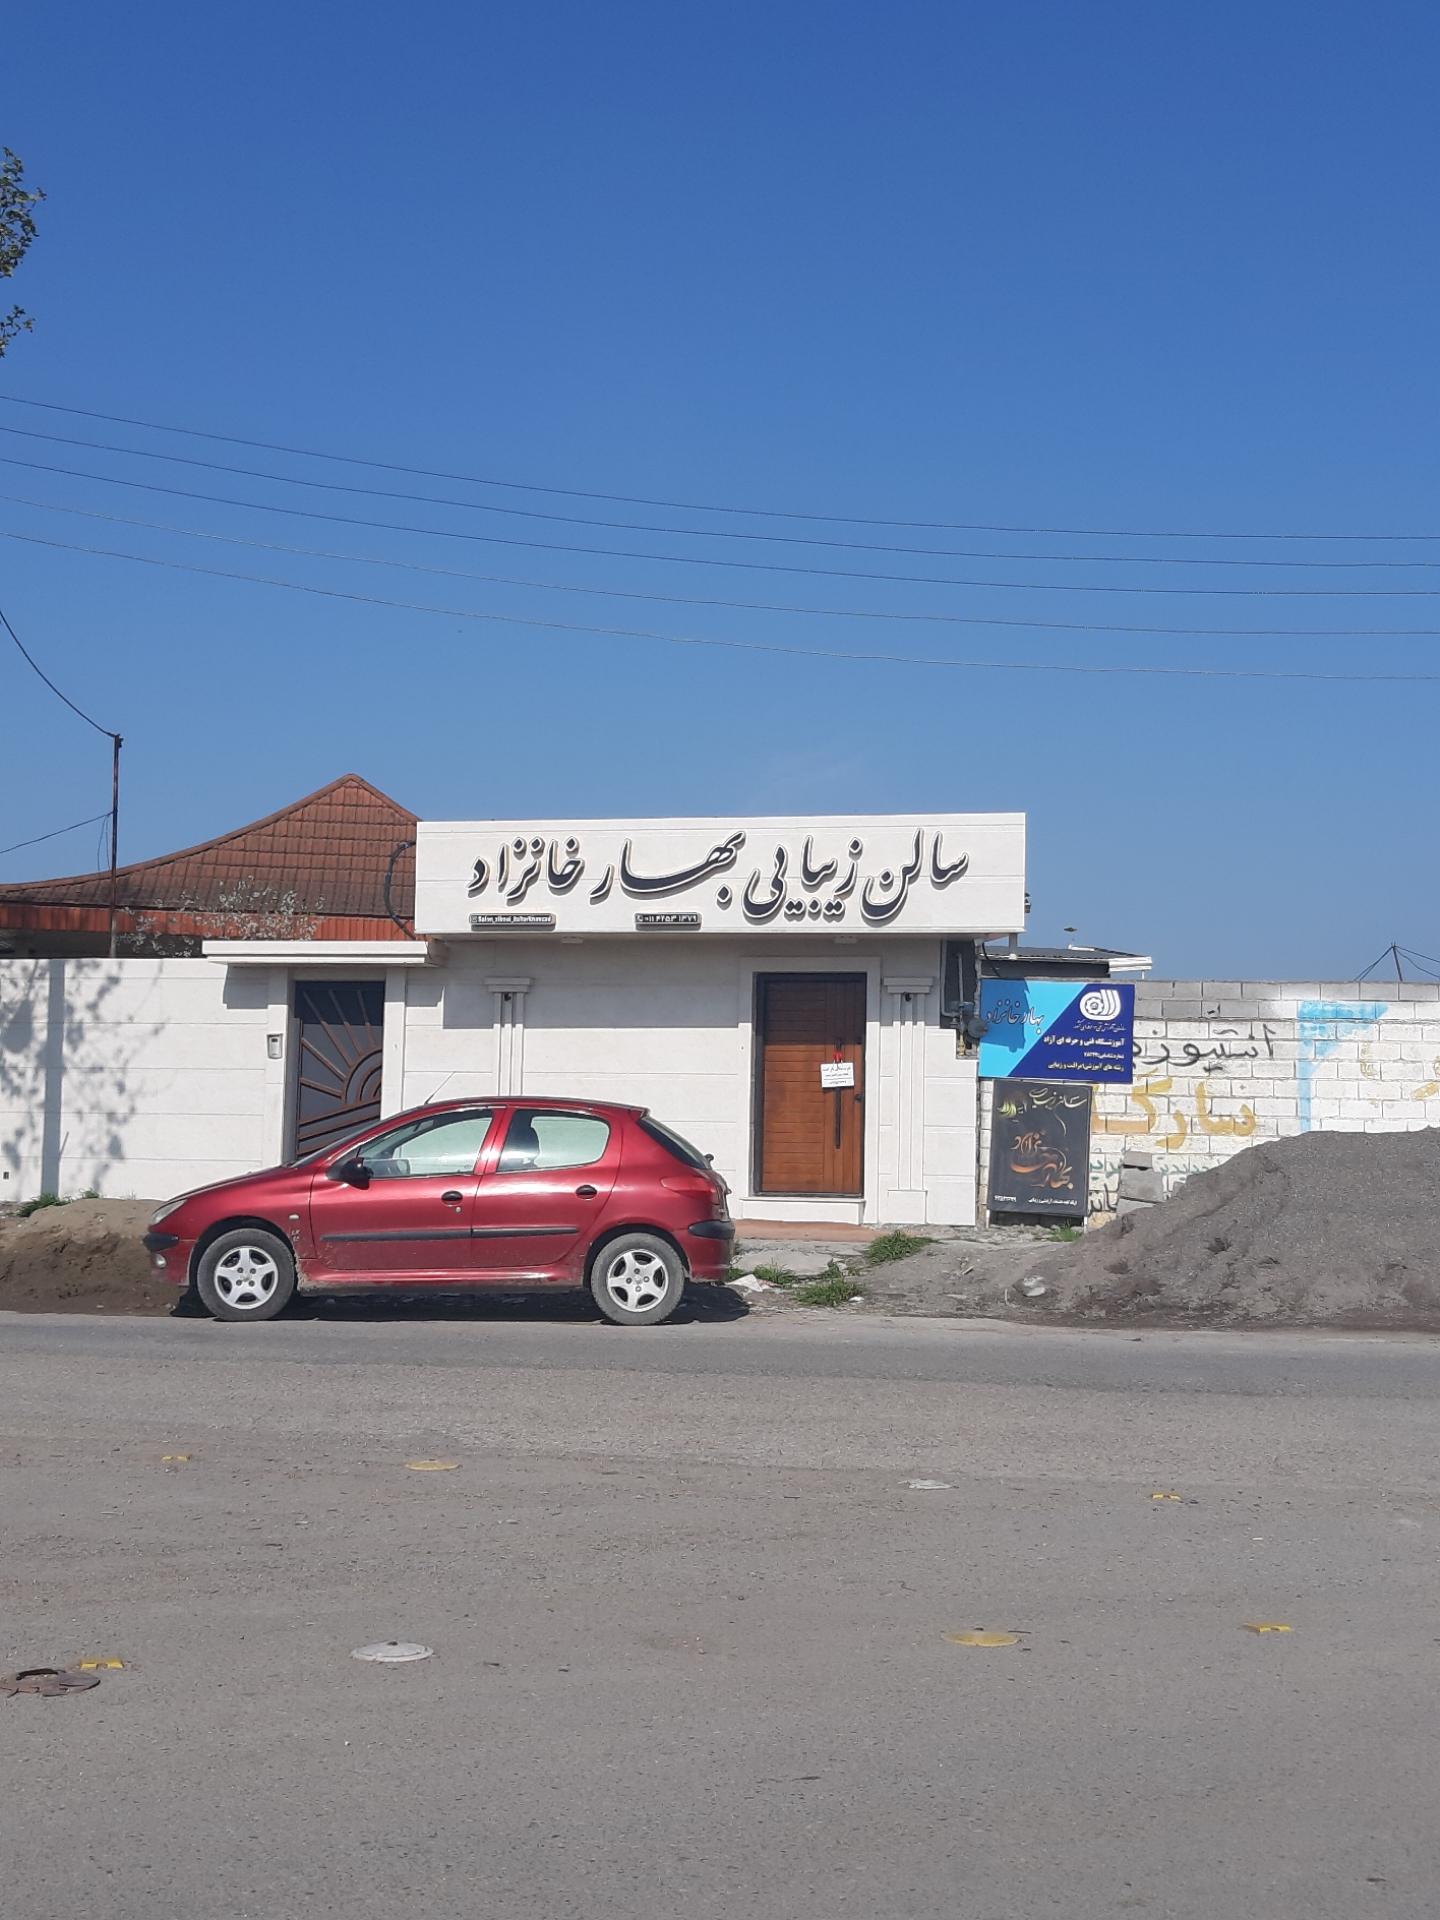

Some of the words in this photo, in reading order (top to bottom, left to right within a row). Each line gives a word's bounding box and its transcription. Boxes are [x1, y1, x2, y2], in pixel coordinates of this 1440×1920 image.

[468, 836, 584, 900] خانزاد
[590, 830, 746, 903] بهار
[743, 835, 862, 920] زیبایی
[861, 828, 969, 920] سالن
[1020, 1006, 1045, 1035] بهار
